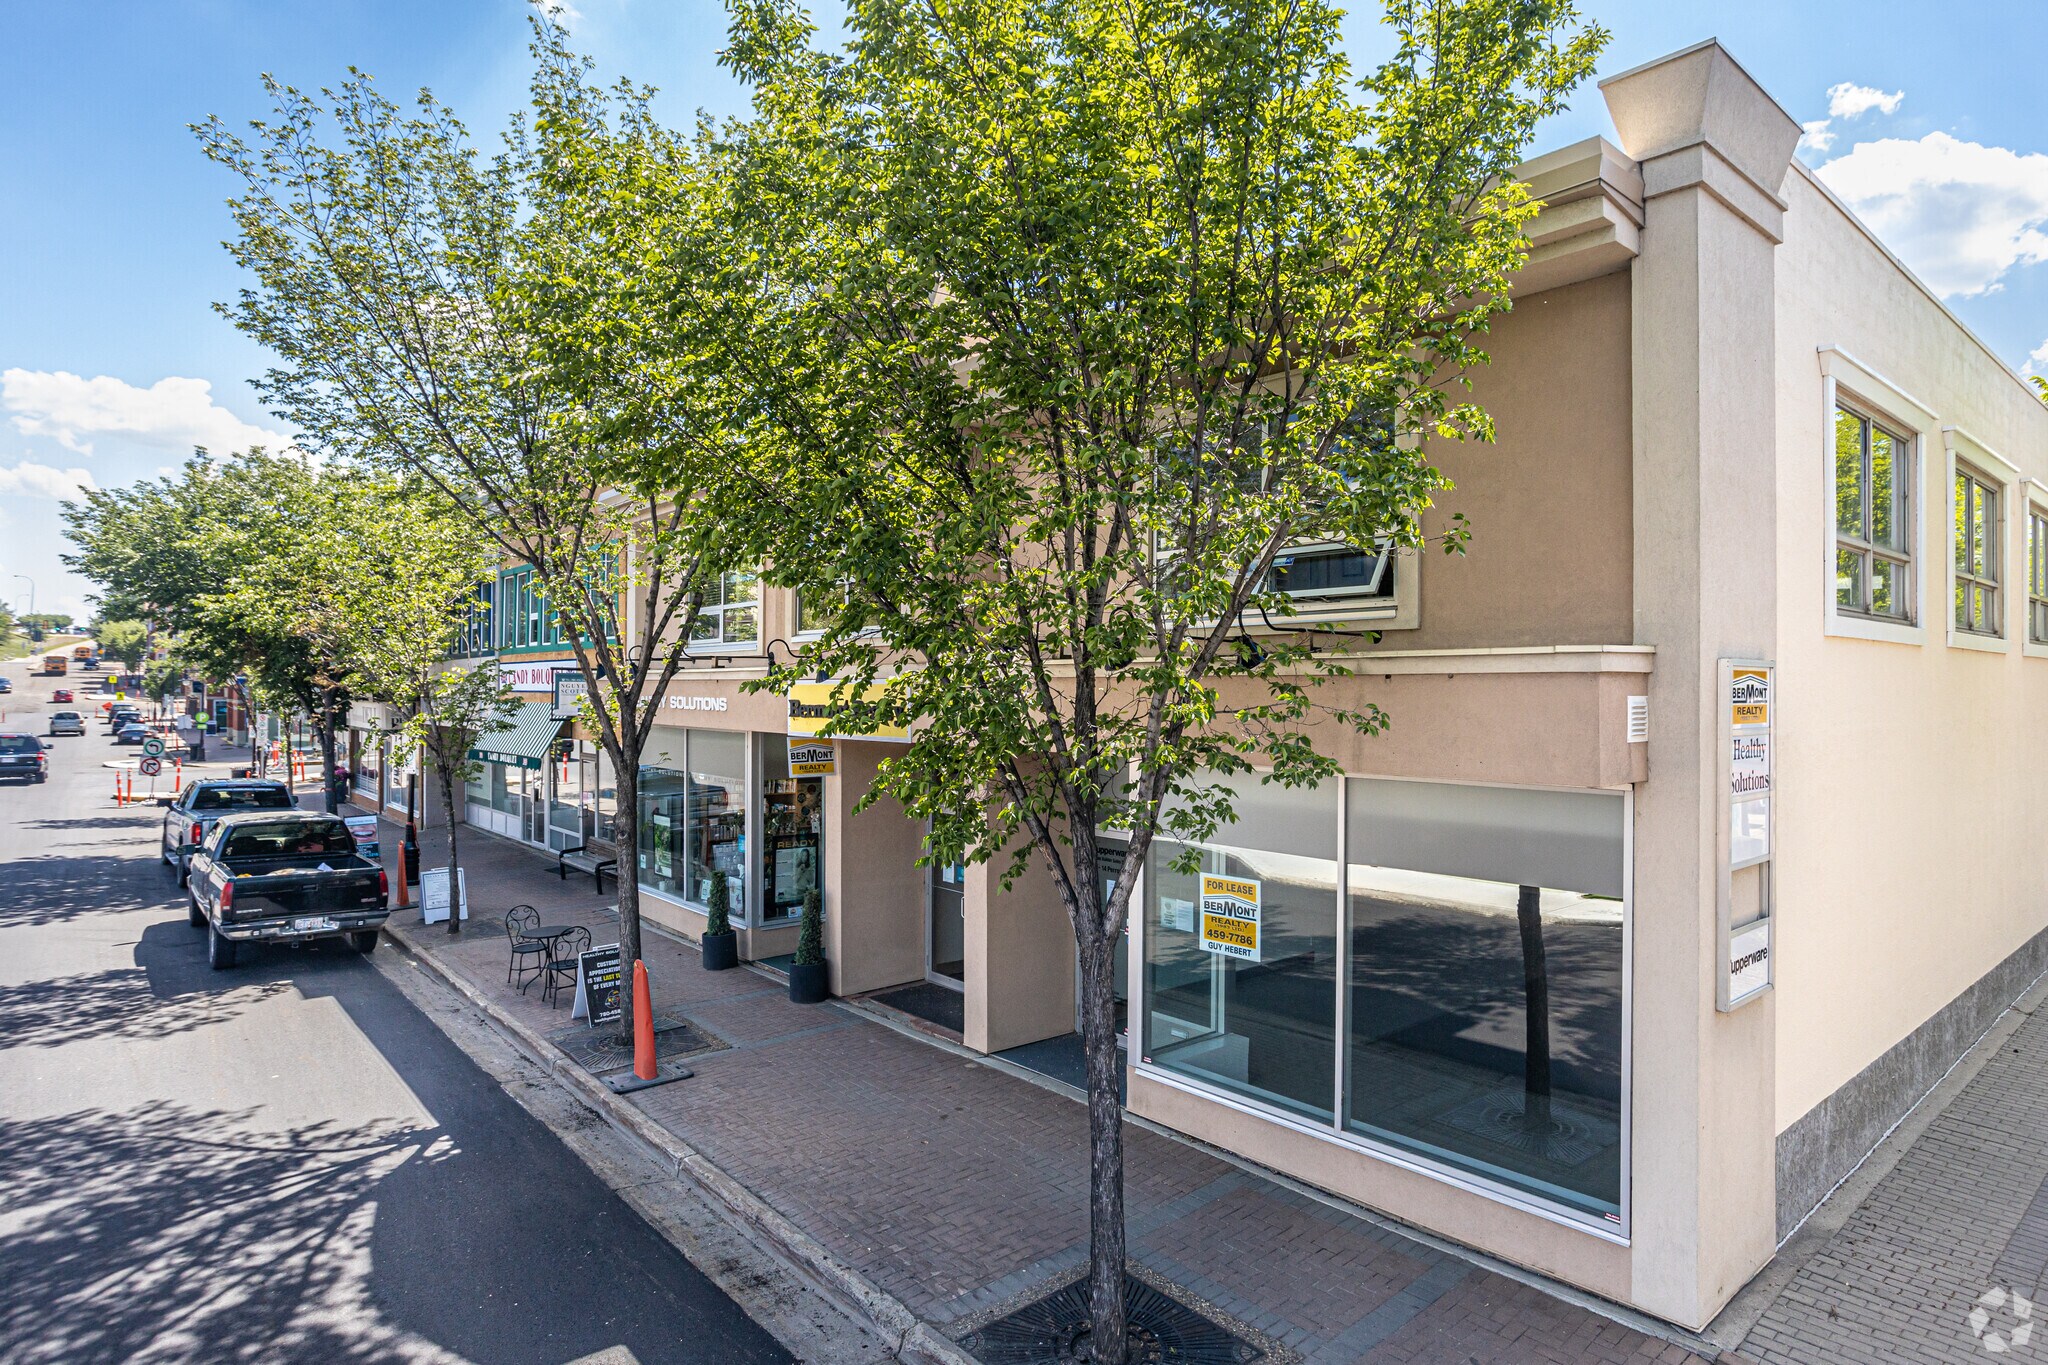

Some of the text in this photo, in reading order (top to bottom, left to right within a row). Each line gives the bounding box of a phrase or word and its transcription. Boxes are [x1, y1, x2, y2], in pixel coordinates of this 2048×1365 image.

[1733, 684, 1767, 703] BERMONT
[670, 696, 727, 711] SOLUTIONS
[1736, 706, 1763, 715] REALTY
[790, 749, 834, 762] BERMONT
[1733, 739, 1766, 762] Healthy
[777, 840, 816, 848] READY
[1207, 880, 1253, 895] FOR LEASE
[1204, 901, 1257, 918] BERMONT
[1211, 916, 1250, 929] REALTY
[1207, 929, 1253, 945] 459-7786
[1208, 942, 1252, 957] GUY HEBERT
[1730, 947, 1767, 975] upperware
